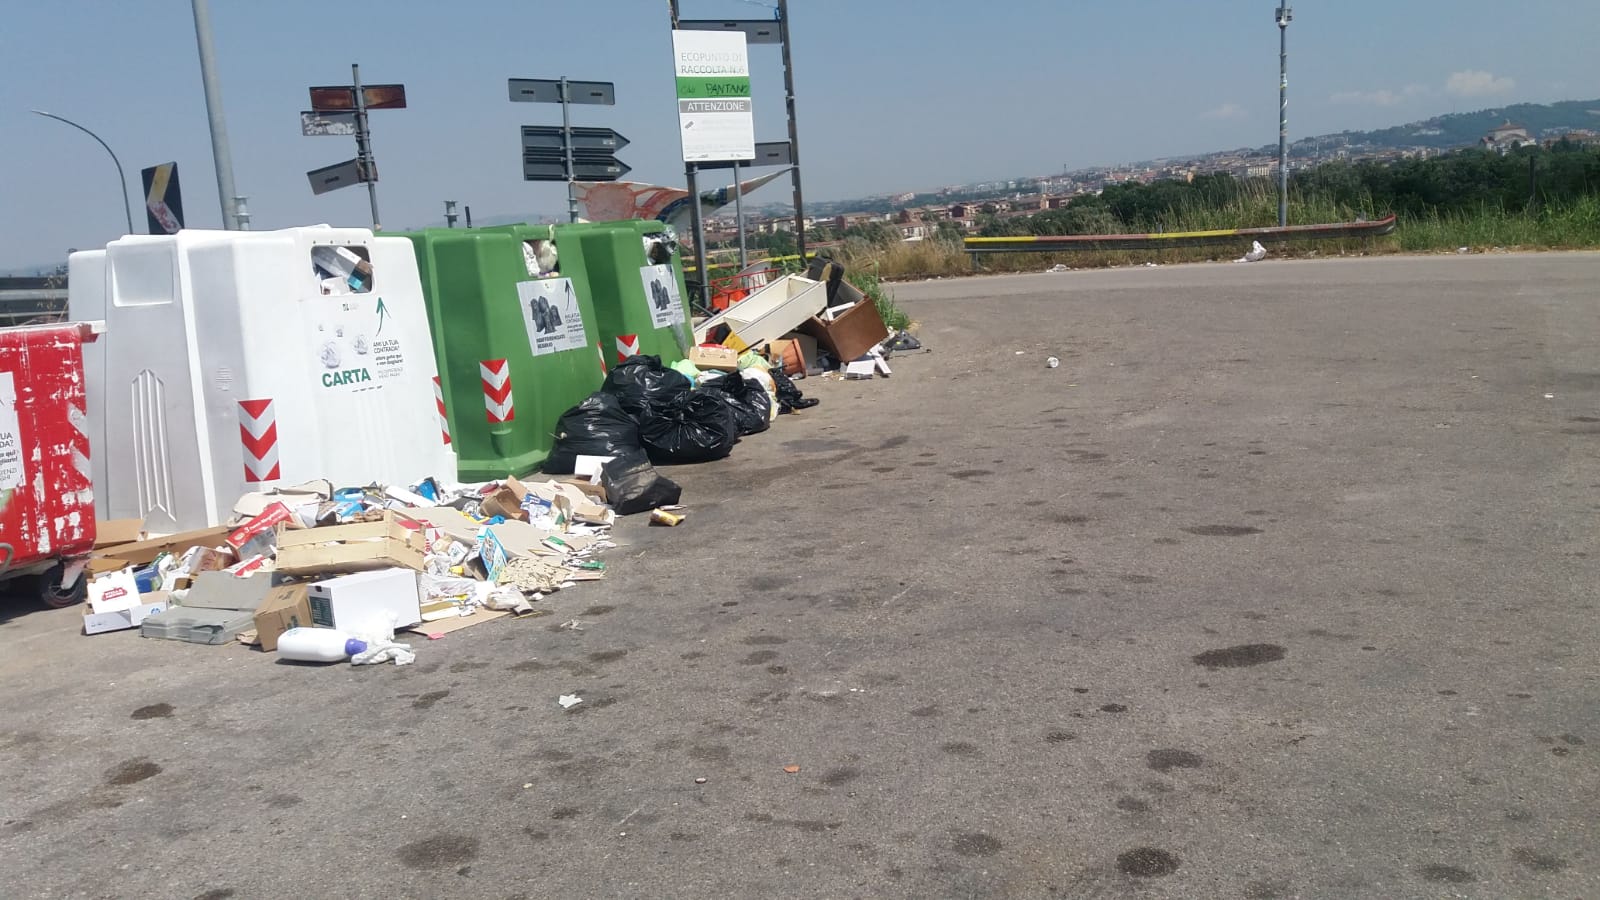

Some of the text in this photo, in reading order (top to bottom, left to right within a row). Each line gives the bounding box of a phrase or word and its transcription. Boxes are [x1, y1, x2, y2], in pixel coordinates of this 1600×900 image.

[681, 52, 742, 61] ECOPUNTO DI
[681, 65, 726, 74] RACCOLTA
[687, 101, 745, 112] ATTENZIONE
[321, 368, 372, 388] CARTA
